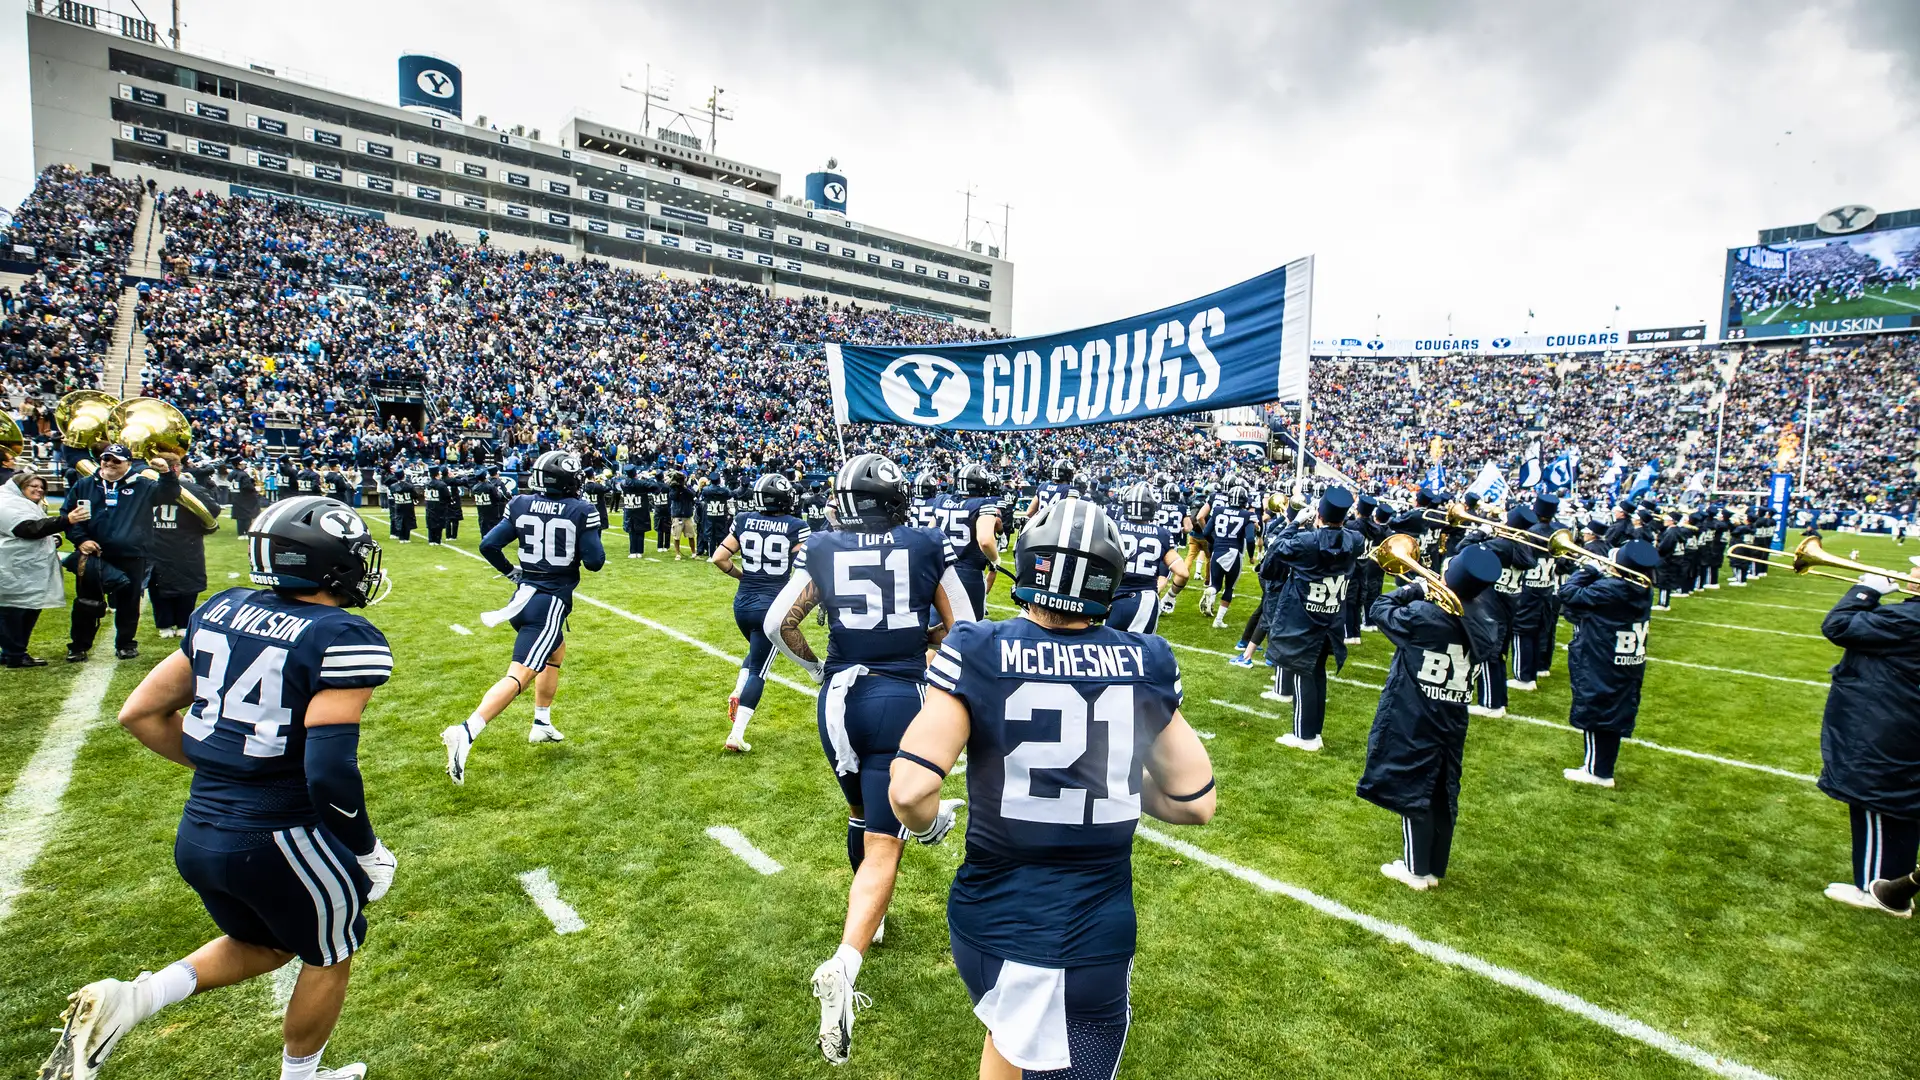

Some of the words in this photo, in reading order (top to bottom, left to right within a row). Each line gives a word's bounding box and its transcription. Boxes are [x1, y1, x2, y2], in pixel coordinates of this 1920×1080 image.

[262, 118, 283, 129] Holiday
[138, 130, 162, 141] Liberty
[318, 132, 338, 141] Holiday
[212, 146, 228, 154] Vegas
[370, 144, 389, 153] Holiday
[601, 129, 645, 147] LAVELL
[654, 143, 707, 163] EDWARDS
[715, 160, 762, 178] STADIUM
[271, 158, 286, 166] Vegas
[1828, 207, 1867, 230] Y
[1654, 331, 1669, 340] PM
[1810, 320, 1838, 334] NU
[1840, 317, 1884, 332] SKIN
[1415, 340, 1479, 350] COUGARS
[1546, 333, 1619, 346] COUGARS
[1046, 306, 1226, 424] COUGS
[373, 394, 394, 402] Portal
[894, 361, 954, 418] Y
[529, 500, 566, 515] MONEY
[707, 501, 725, 512] BYU
[1038, 491, 1061, 511] 64
[744, 518, 789, 534] PETERMAN
[935, 510, 971, 547] 75
[1120, 523, 1158, 535] FAKAHUA
[1158, 510, 1183, 533] 23
[1215, 514, 1245, 538] 87
[515, 514, 577, 566] 30
[739, 531, 791, 575] 99
[1122, 534, 1161, 576] 22
[834, 549, 920, 630] 51
[1035, 573, 1046, 586] 21
[1034, 592, 1048, 605] GO
[1048, 597, 1083, 613] COUGS
[202, 598, 231, 625] Jo.
[230, 604, 313, 643] WILSON
[1000, 639, 1146, 677] McCHESNEY
[182, 628, 292, 758] 34
[1000, 682, 1142, 825] 21
